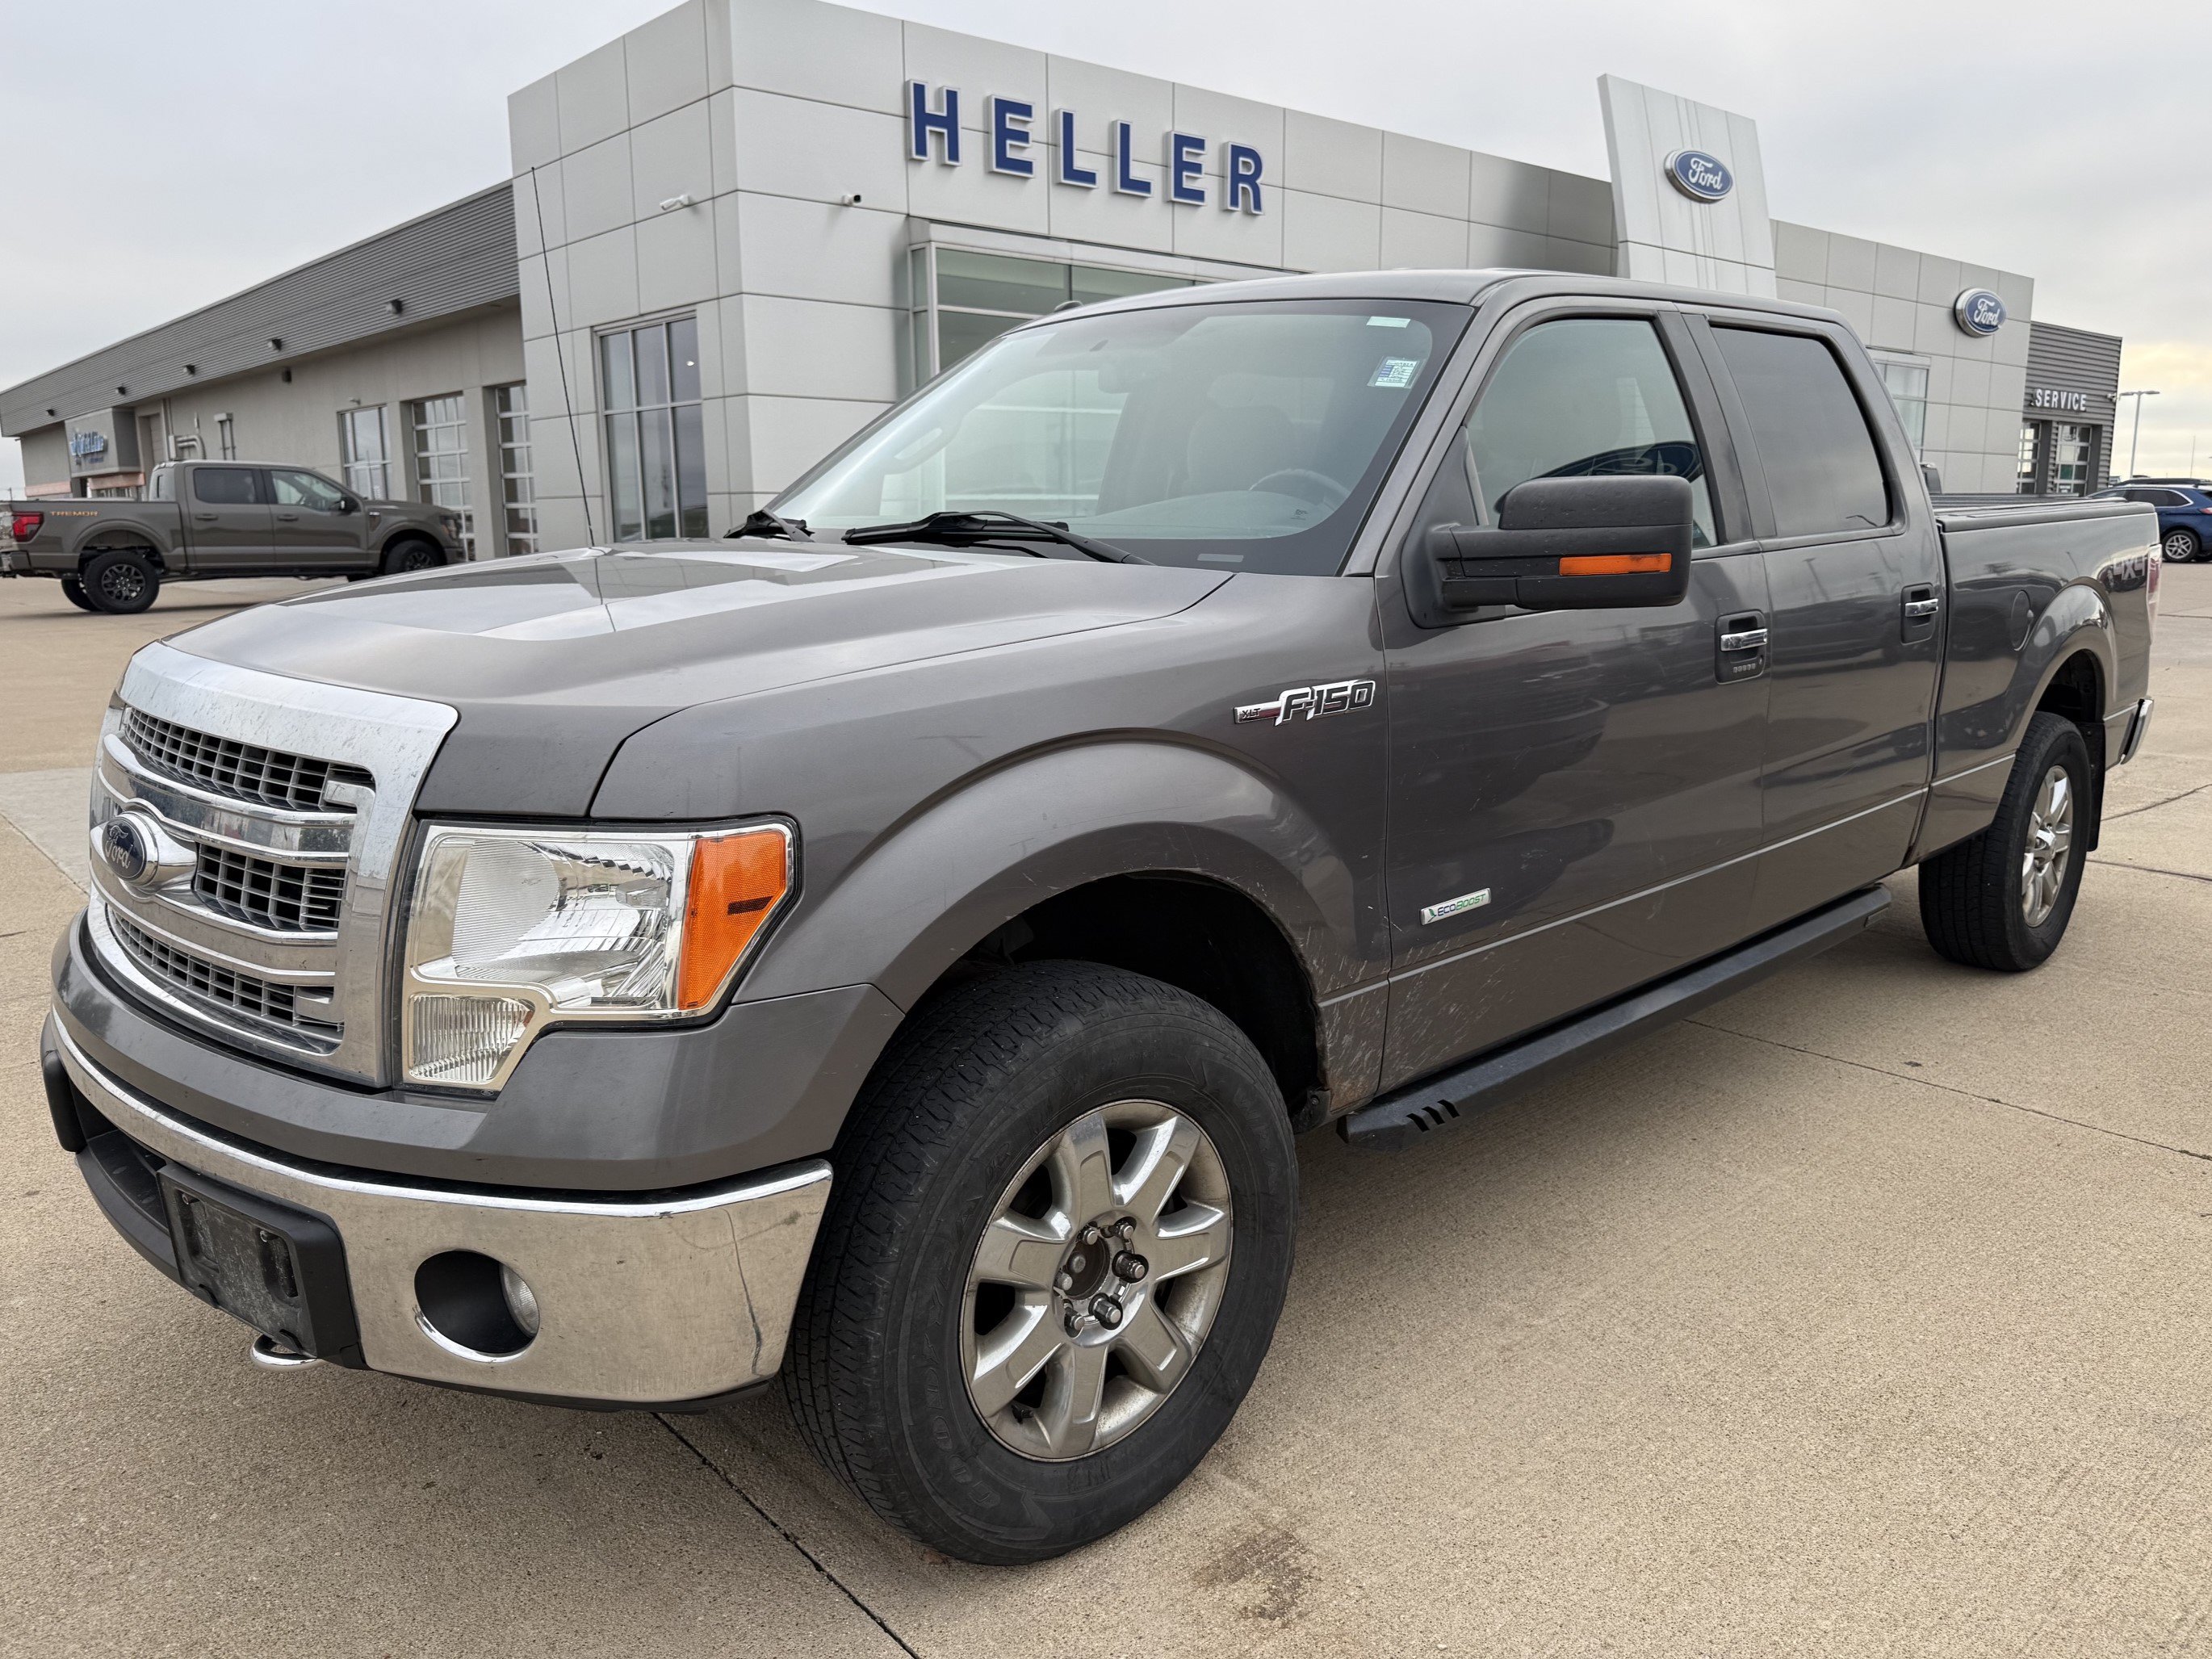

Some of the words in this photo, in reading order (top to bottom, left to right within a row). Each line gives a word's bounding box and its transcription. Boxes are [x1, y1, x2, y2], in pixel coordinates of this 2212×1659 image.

[907, 79, 1265, 216] HELLER
[1688, 157, 1724, 190] Ford
[1974, 298, 1999, 326] Ford
[2035, 388, 2087, 412] SERVICE
[1242, 708, 1261, 719] XLT
[105, 825, 134, 869] Ford
